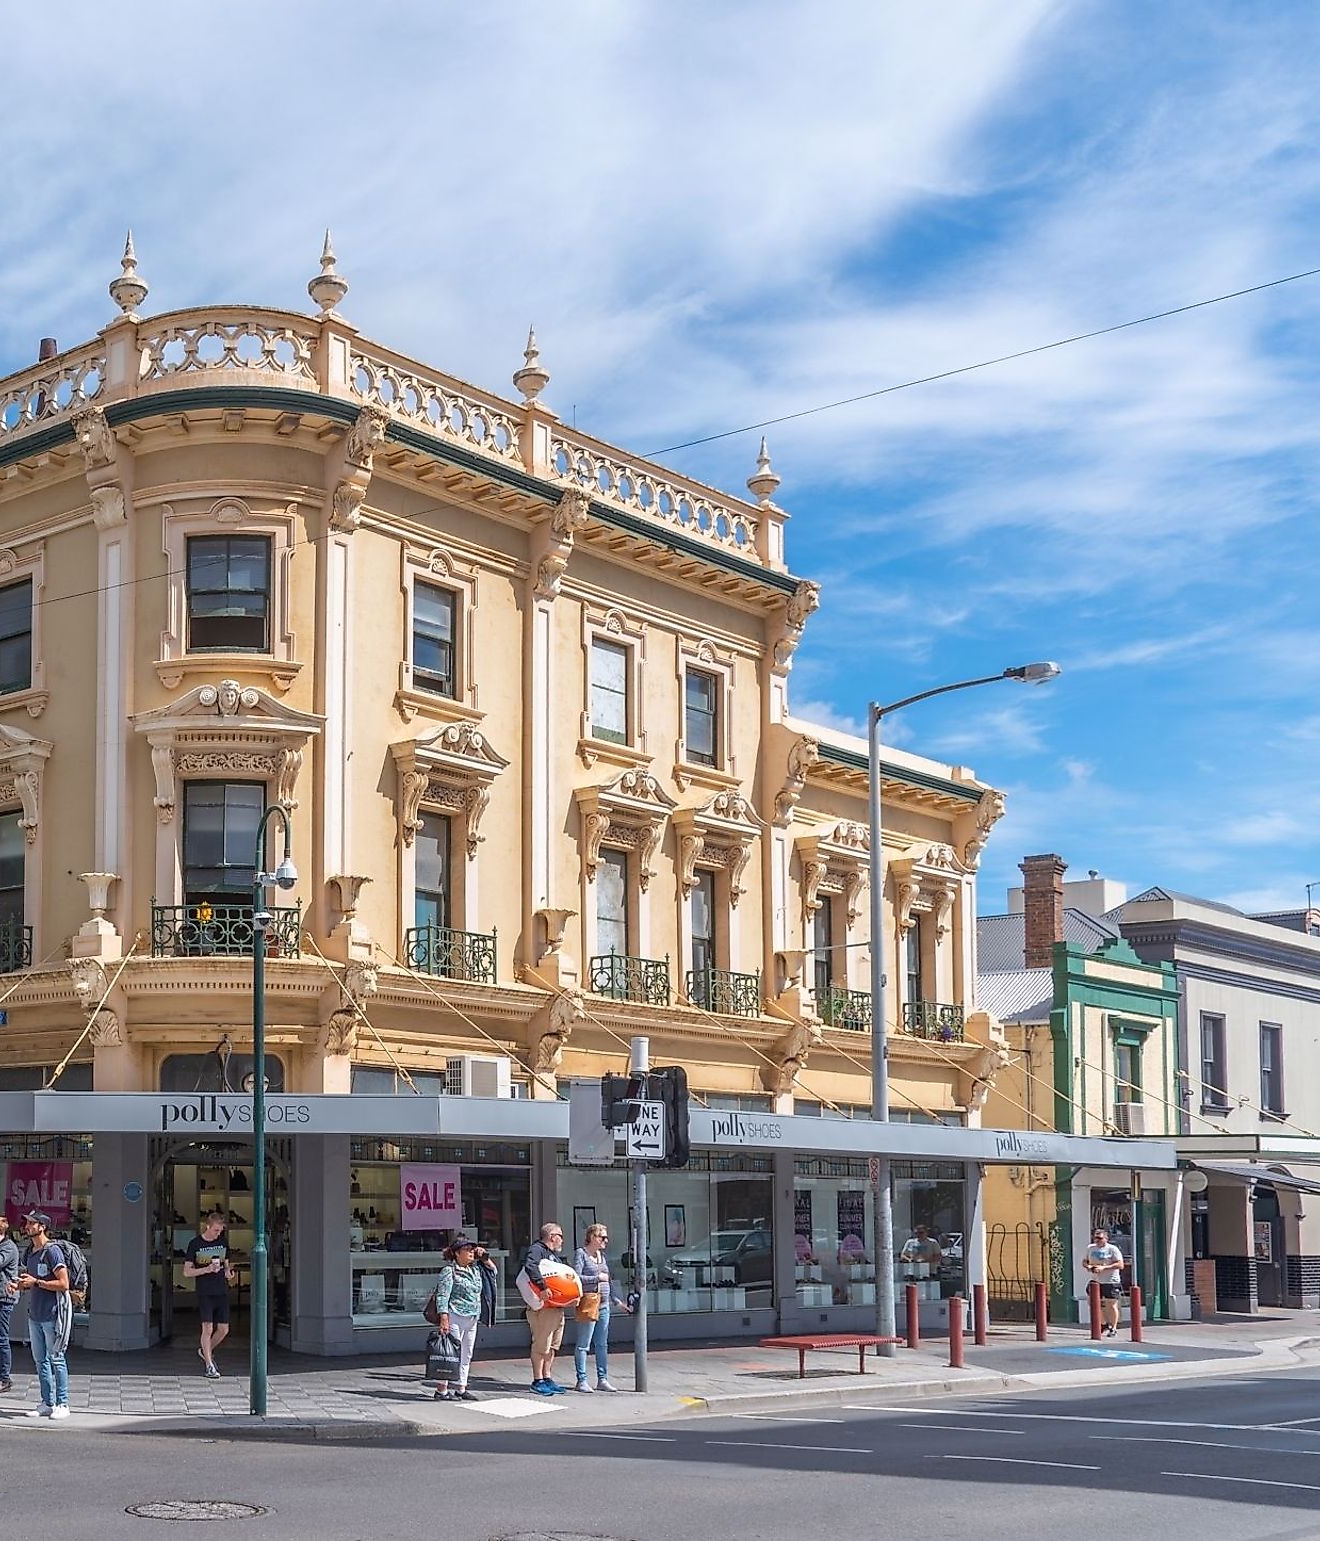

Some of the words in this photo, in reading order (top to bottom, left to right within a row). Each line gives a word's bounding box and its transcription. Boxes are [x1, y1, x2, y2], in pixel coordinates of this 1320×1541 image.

[238, 1104, 310, 1123] SOES
[642, 1106, 659, 1119] NE
[631, 1123, 660, 1137] WAY
[10, 1179, 69, 1207] SALE
[405, 1182, 456, 1210] SALE
